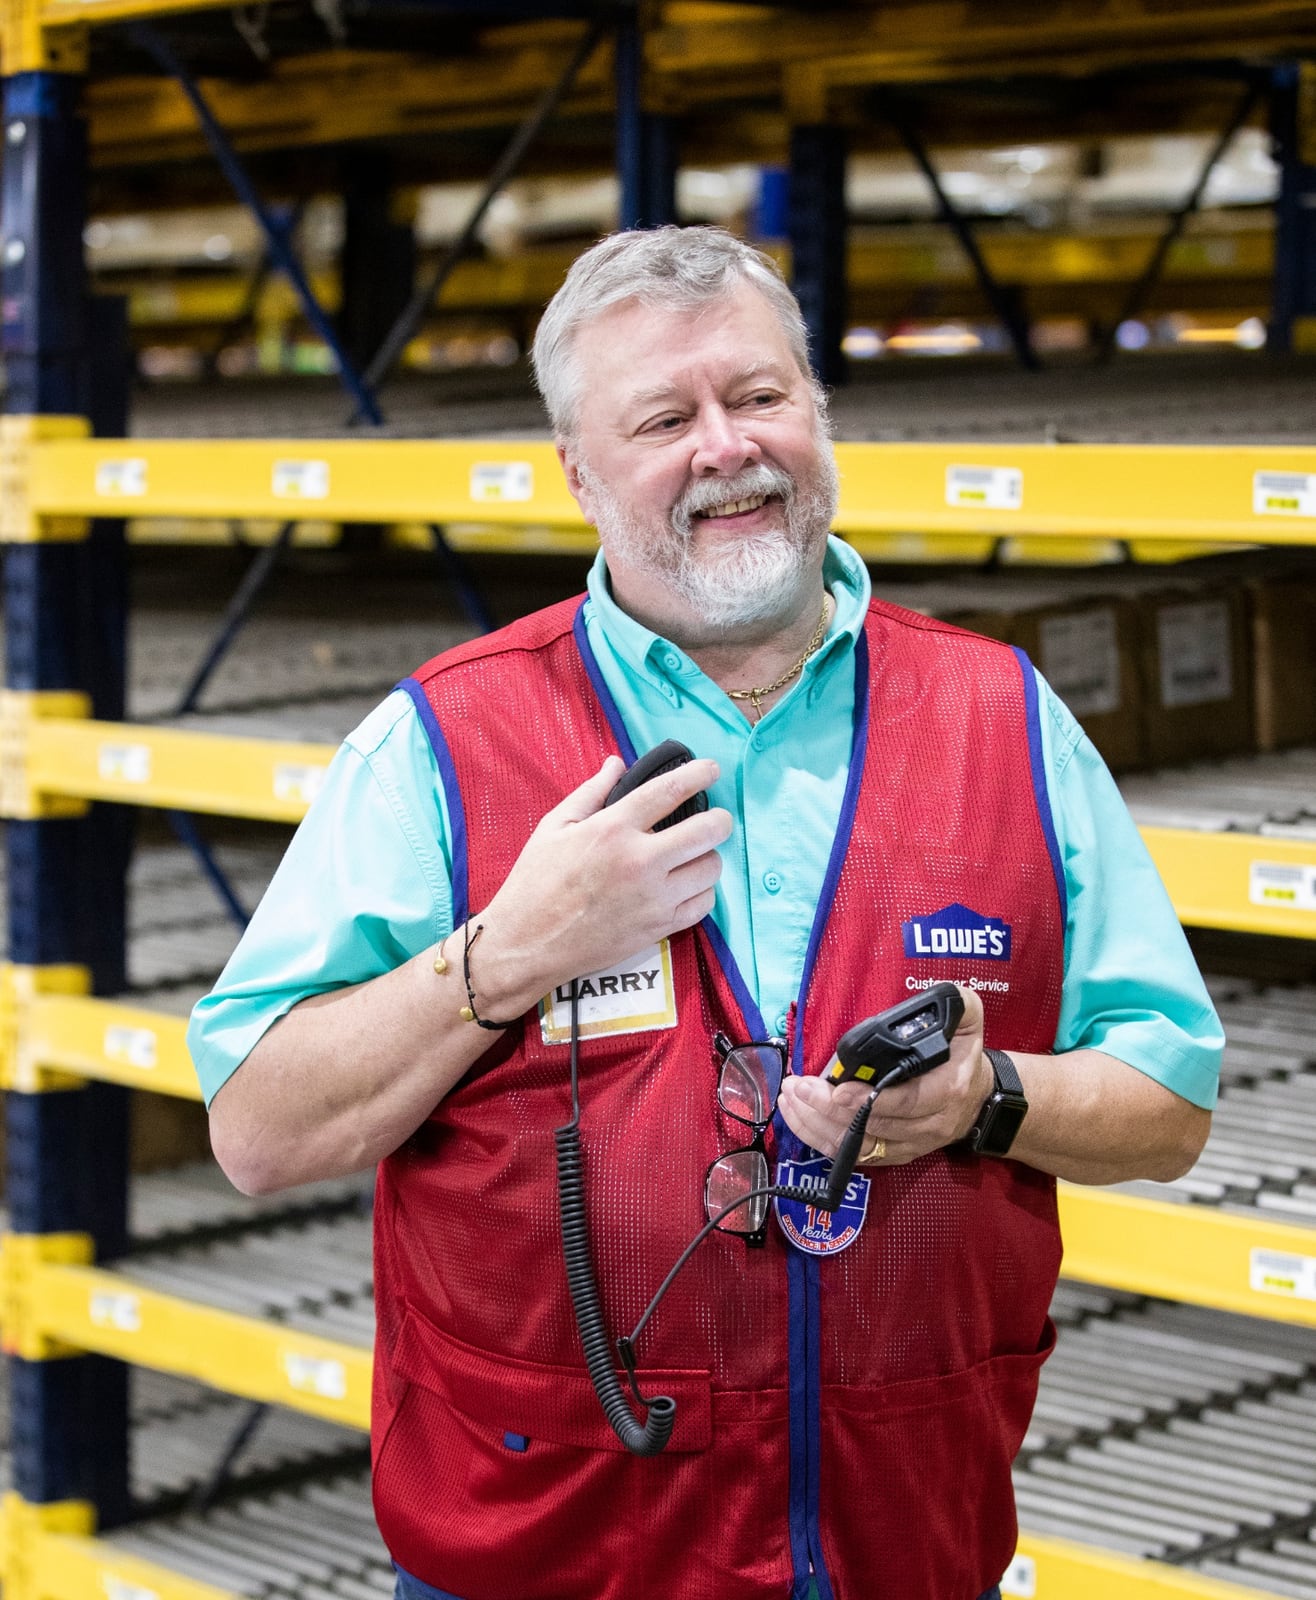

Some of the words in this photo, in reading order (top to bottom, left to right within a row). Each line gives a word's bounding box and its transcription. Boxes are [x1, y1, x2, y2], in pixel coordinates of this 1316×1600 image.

[913, 923, 1006, 956] LOWE'S
[968, 977, 1010, 992] Service
[805, 1204, 832, 1231] 14
[800, 1224, 833, 1241] Years
[828, 1226, 856, 1250] SERVICE
